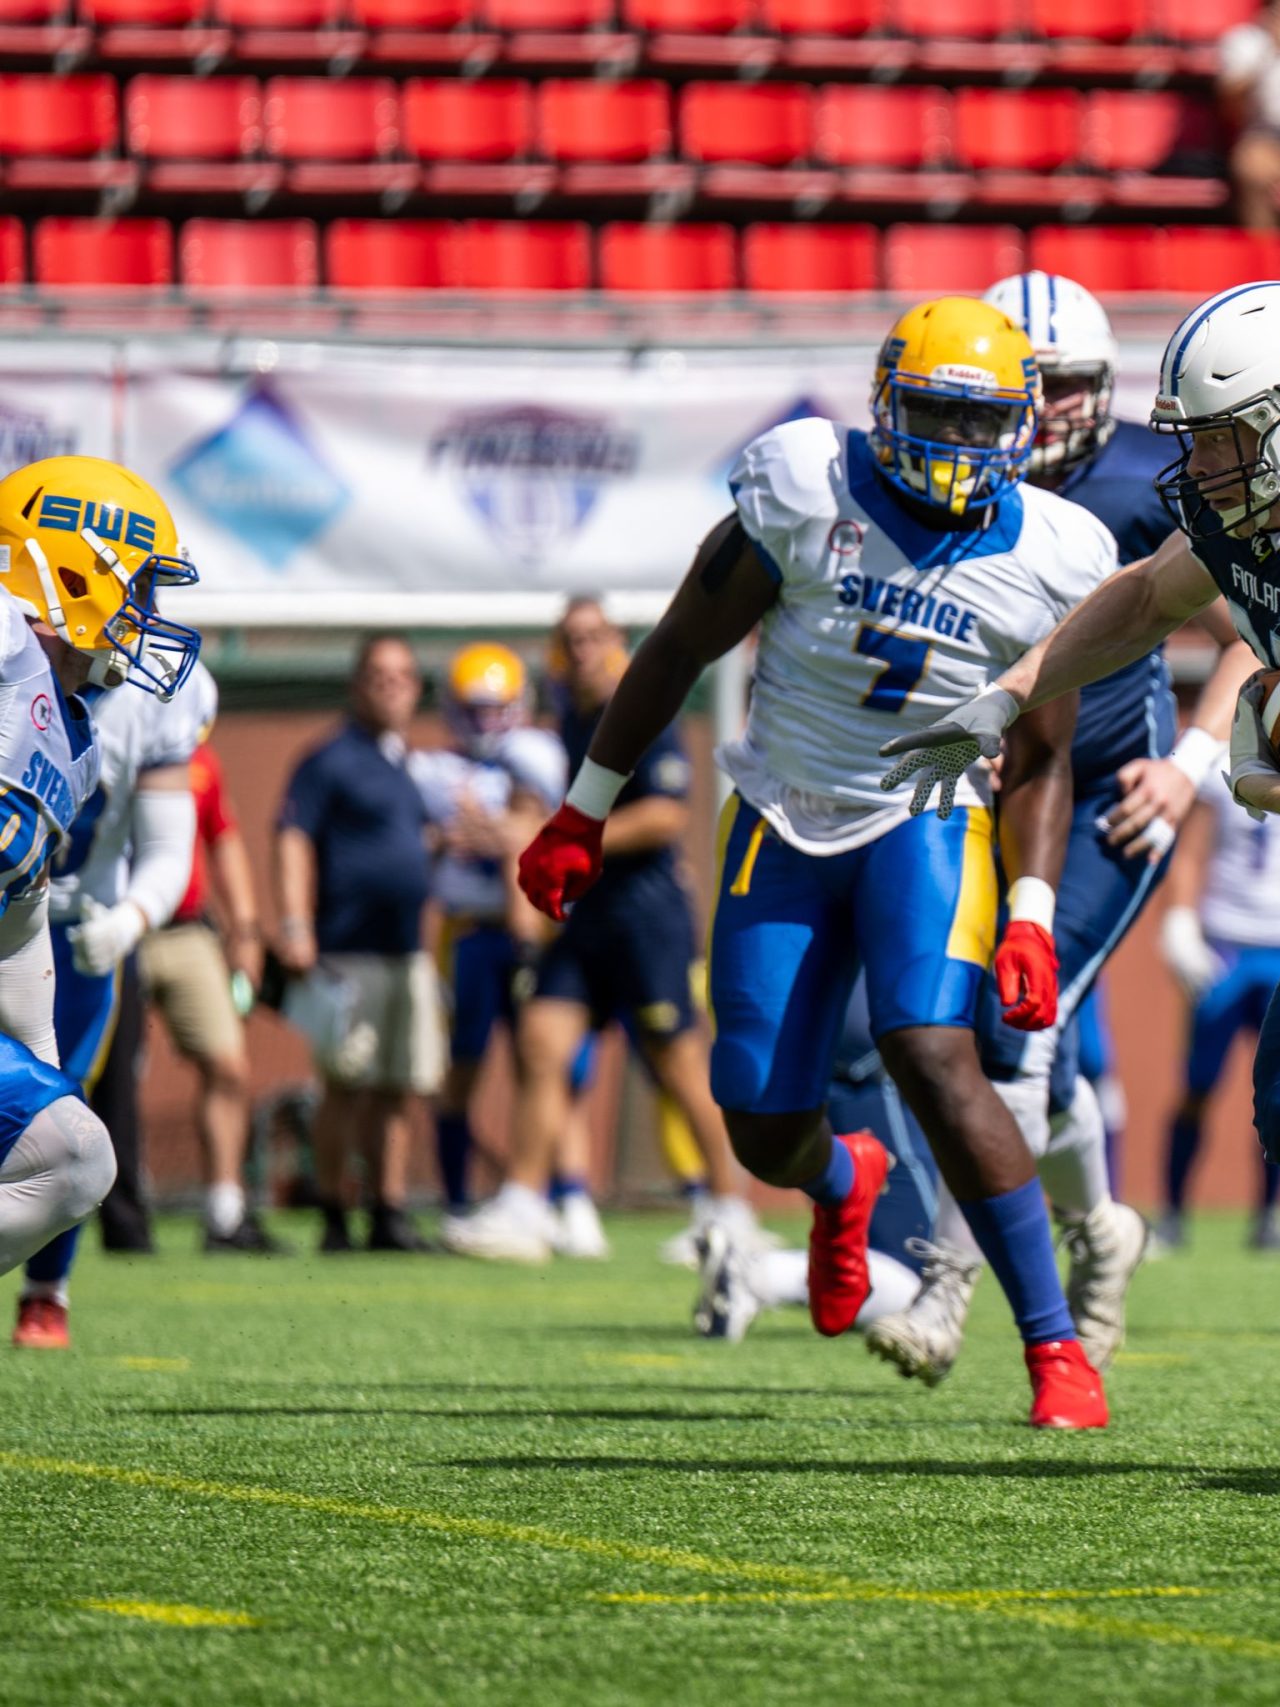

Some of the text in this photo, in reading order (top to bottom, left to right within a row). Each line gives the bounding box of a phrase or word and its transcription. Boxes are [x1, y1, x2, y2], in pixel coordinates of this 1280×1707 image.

[38, 494, 156, 553] SWE
[838, 574, 979, 643] SVERIGE
[853, 619, 935, 716] 7
